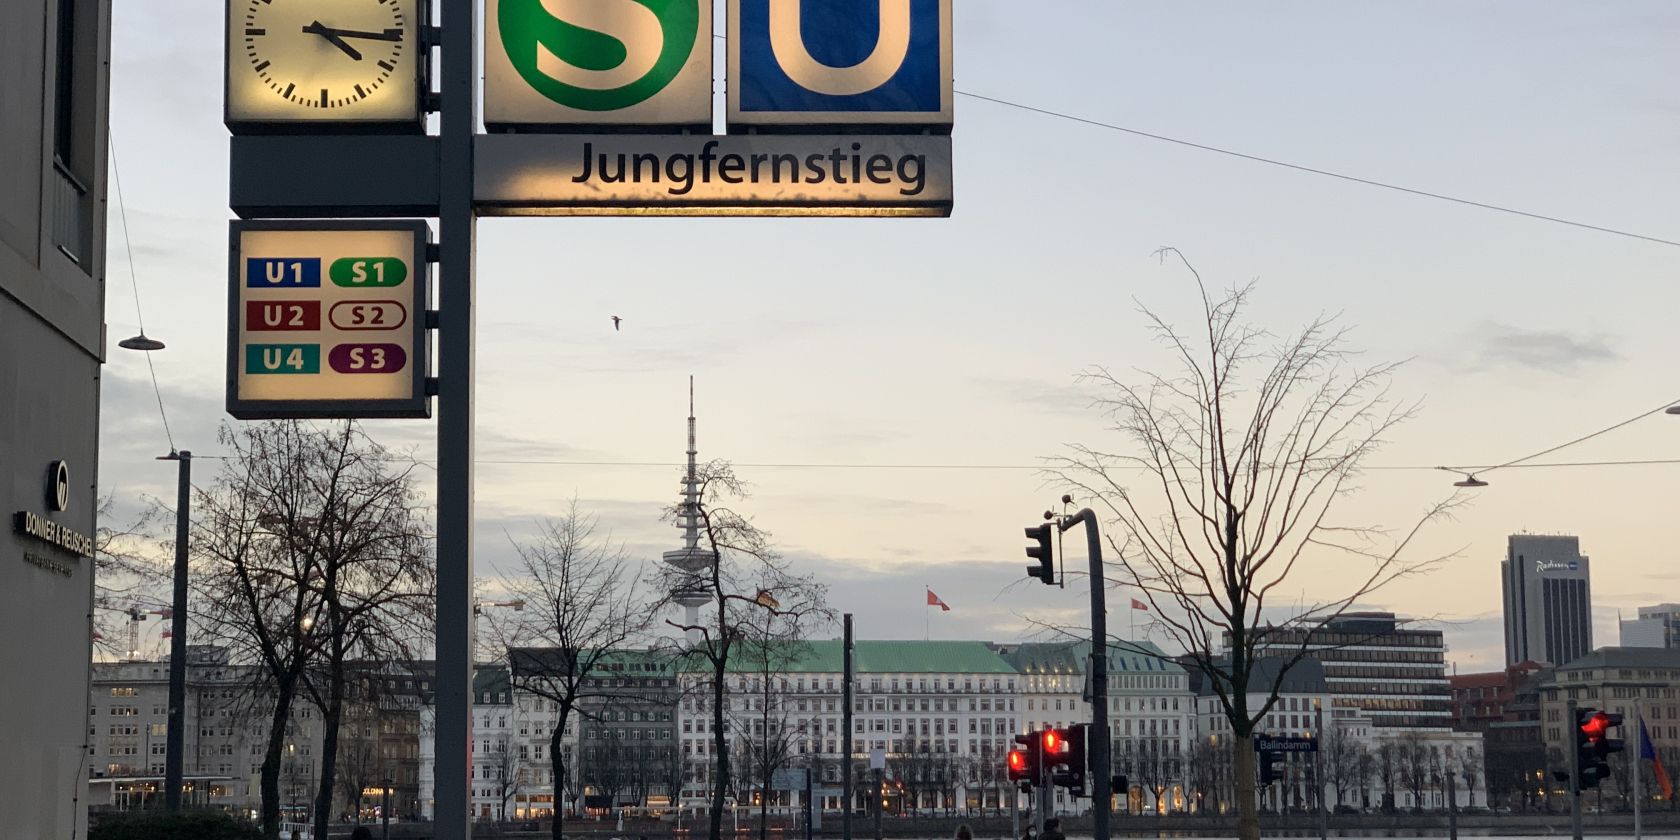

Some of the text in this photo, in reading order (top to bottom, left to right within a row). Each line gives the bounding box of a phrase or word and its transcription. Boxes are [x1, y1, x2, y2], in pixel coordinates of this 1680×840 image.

[572, 141, 926, 195] Jungfernstieg
[265, 261, 303, 283] U1
[352, 261, 384, 283] S1
[264, 305, 304, 326] U2
[352, 306, 384, 325] S2
[263, 348, 304, 370] U4
[350, 348, 386, 370] S3
[26, 511, 94, 558] DONNER & REUSCHEL
[1260, 740, 1311, 750] Ballindamm
